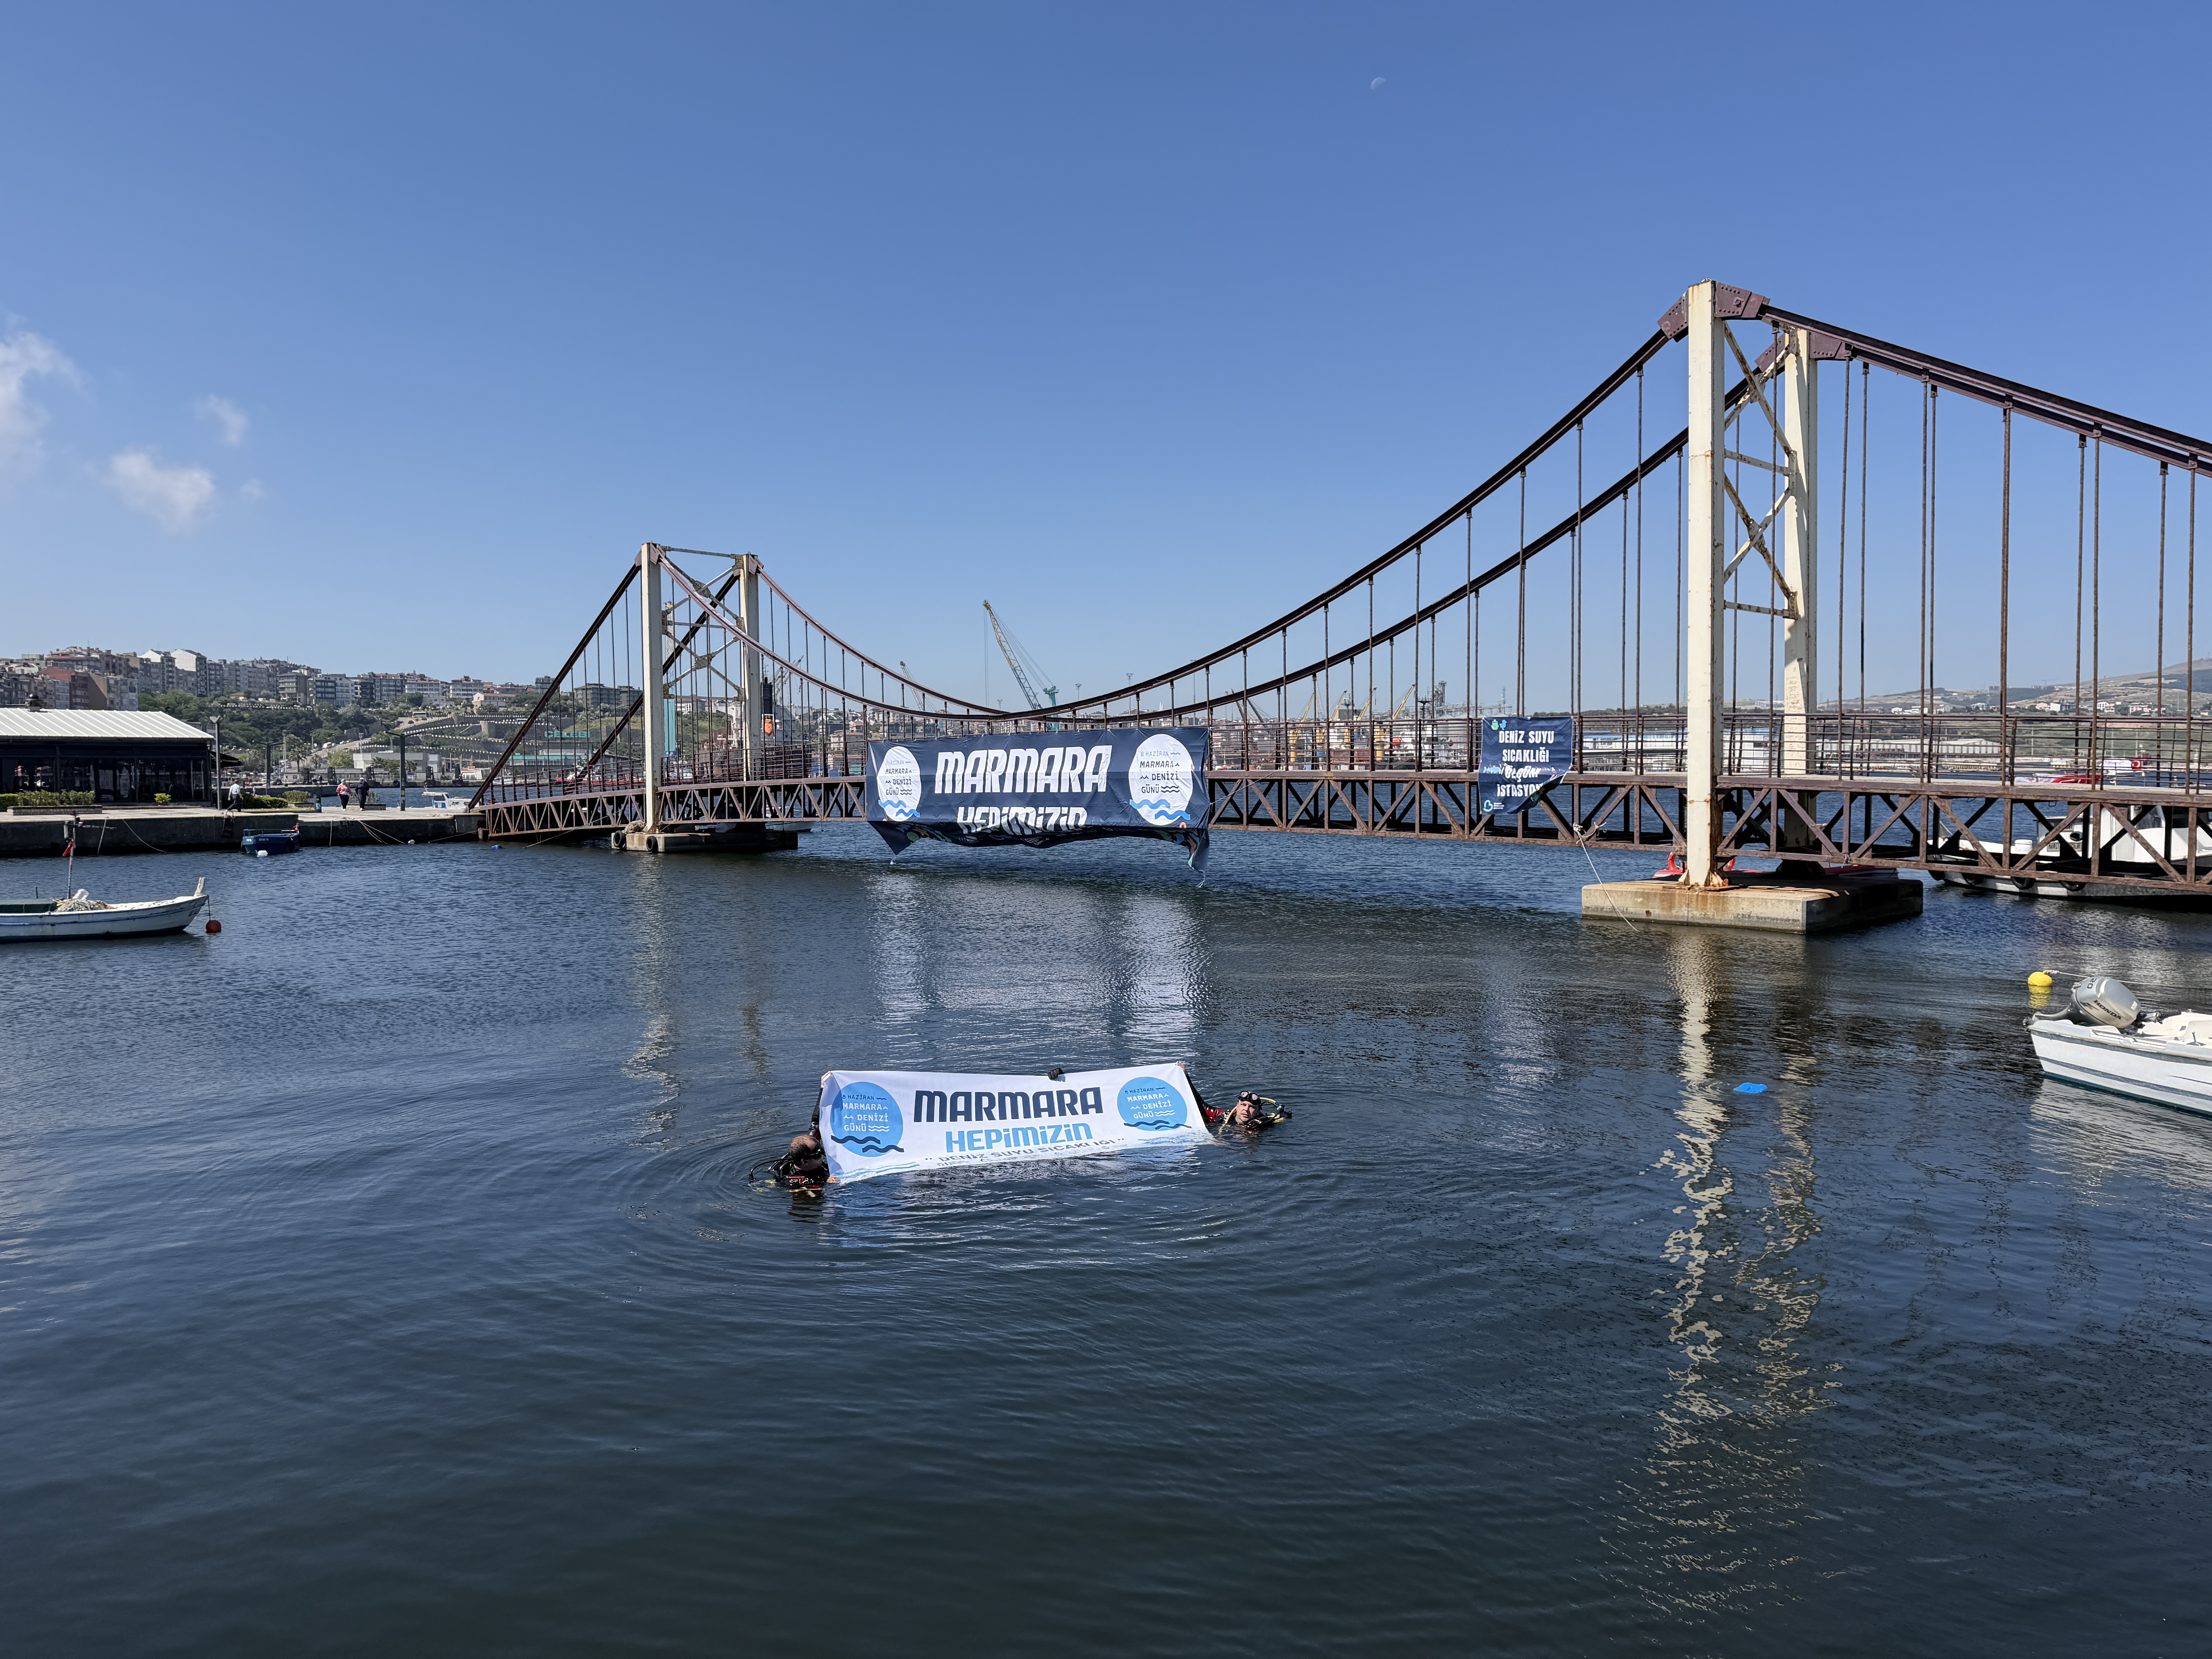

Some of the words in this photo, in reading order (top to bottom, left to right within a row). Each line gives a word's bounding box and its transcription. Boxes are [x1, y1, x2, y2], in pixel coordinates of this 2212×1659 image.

[1499, 730, 1525, 744] DENİZ
[1528, 731, 1554, 744] SUYU
[1502, 747, 1549, 762] SICAKLIĞI
[935, 745, 1112, 793] MARMARA
[1152, 771, 1179, 780] DENİZİ
[893, 776, 912, 785] DENİZİ
[886, 787, 899, 795] GÜNÜ
[1141, 784, 1159, 793] GÜNÜ
[2094, 999, 2121, 1020] HONDA
[1127, 1093, 1164, 1102] MARMARA
[914, 1087, 1103, 1122] MARMARA
[1143, 1099, 1172, 1109] DENİZİ
[857, 1113, 888, 1122] DENİZİ
[1133, 1111, 1154, 1119] GÜNÜ
[844, 1123, 867, 1132] GÜNÜ
[991, 1149, 1034, 1157] SUYU
